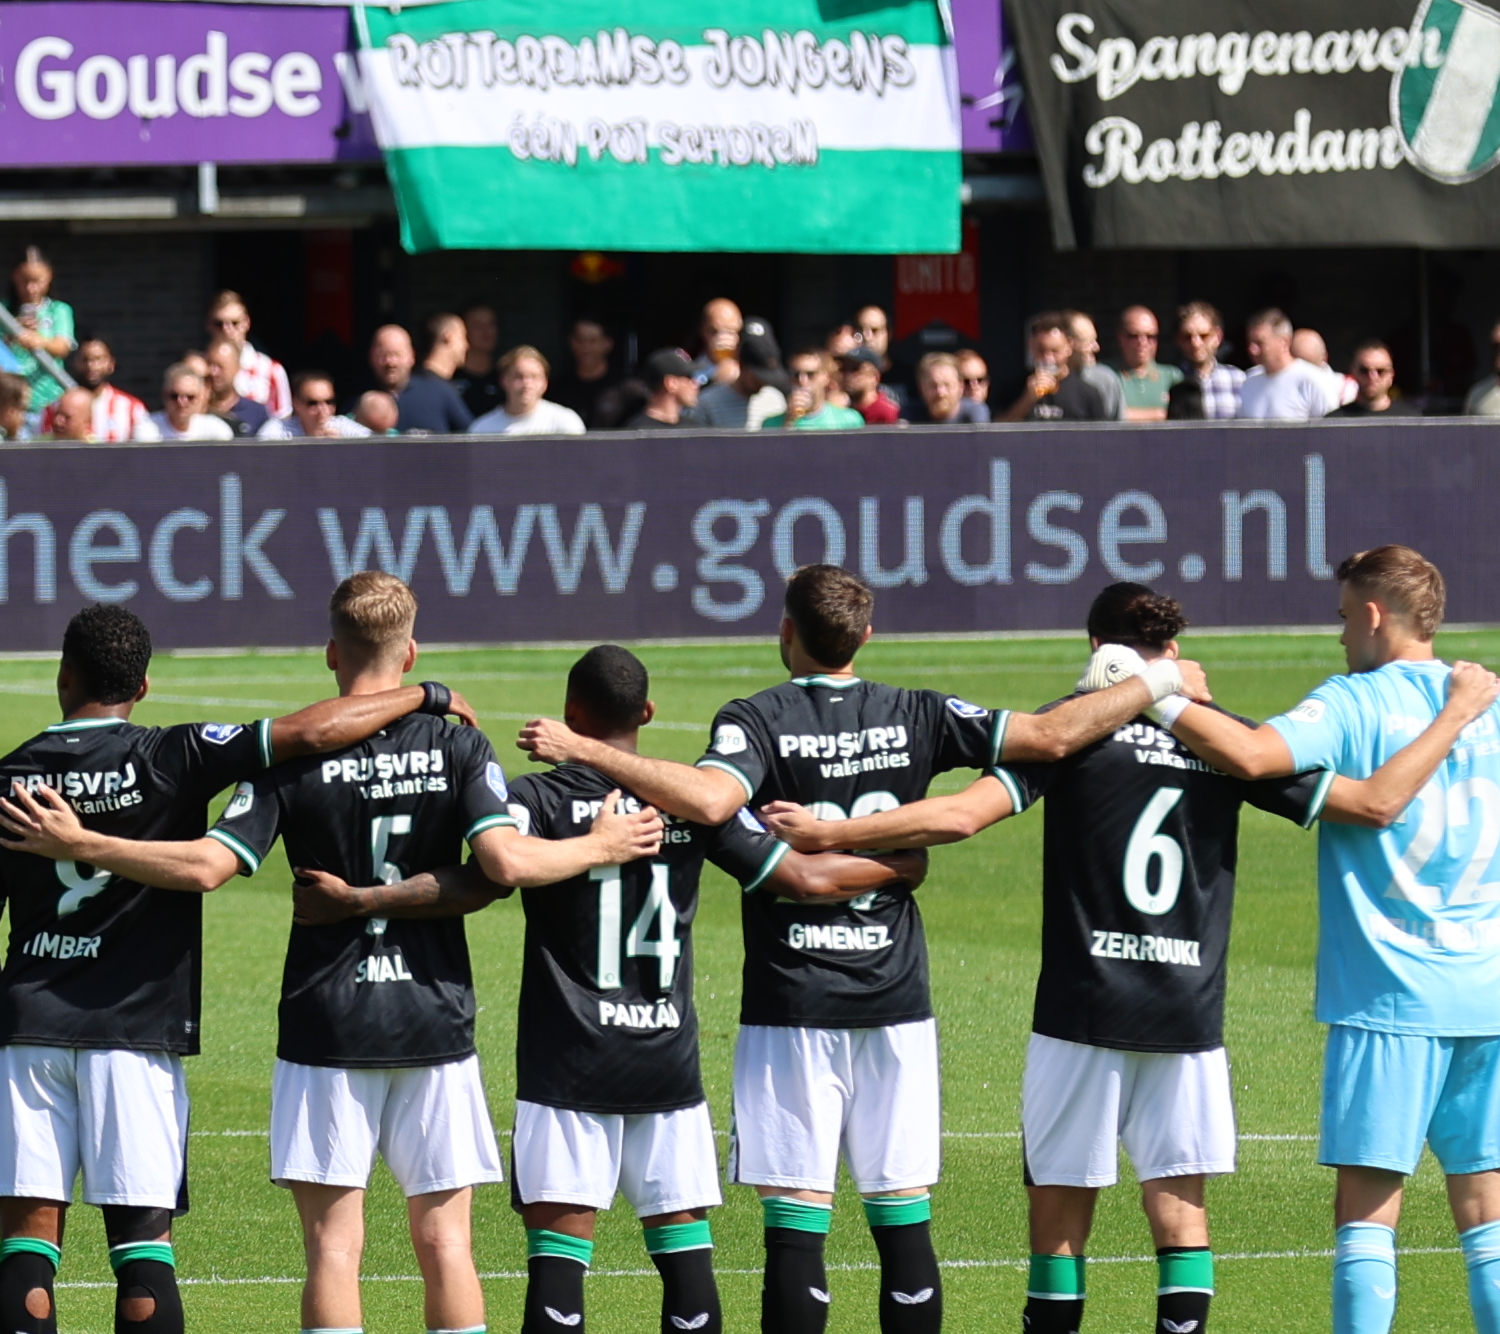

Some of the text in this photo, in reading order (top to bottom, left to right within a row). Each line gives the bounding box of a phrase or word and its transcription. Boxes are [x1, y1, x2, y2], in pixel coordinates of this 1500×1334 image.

[15, 31, 323, 120] Goudse
[1050, 12, 1448, 101] Spangenaren
[590, 120, 649, 164] POT
[1083, 108, 1405, 188] Rotterdam
[318, 454, 1338, 623] www.goudse.nl
[69, 788, 143, 815] kanties
[1123, 787, 1183, 916] 6
[589, 863, 681, 990] 14
[789, 923, 893, 950] GIMENEZ
[1090, 930, 1201, 966] ZERROUKI
